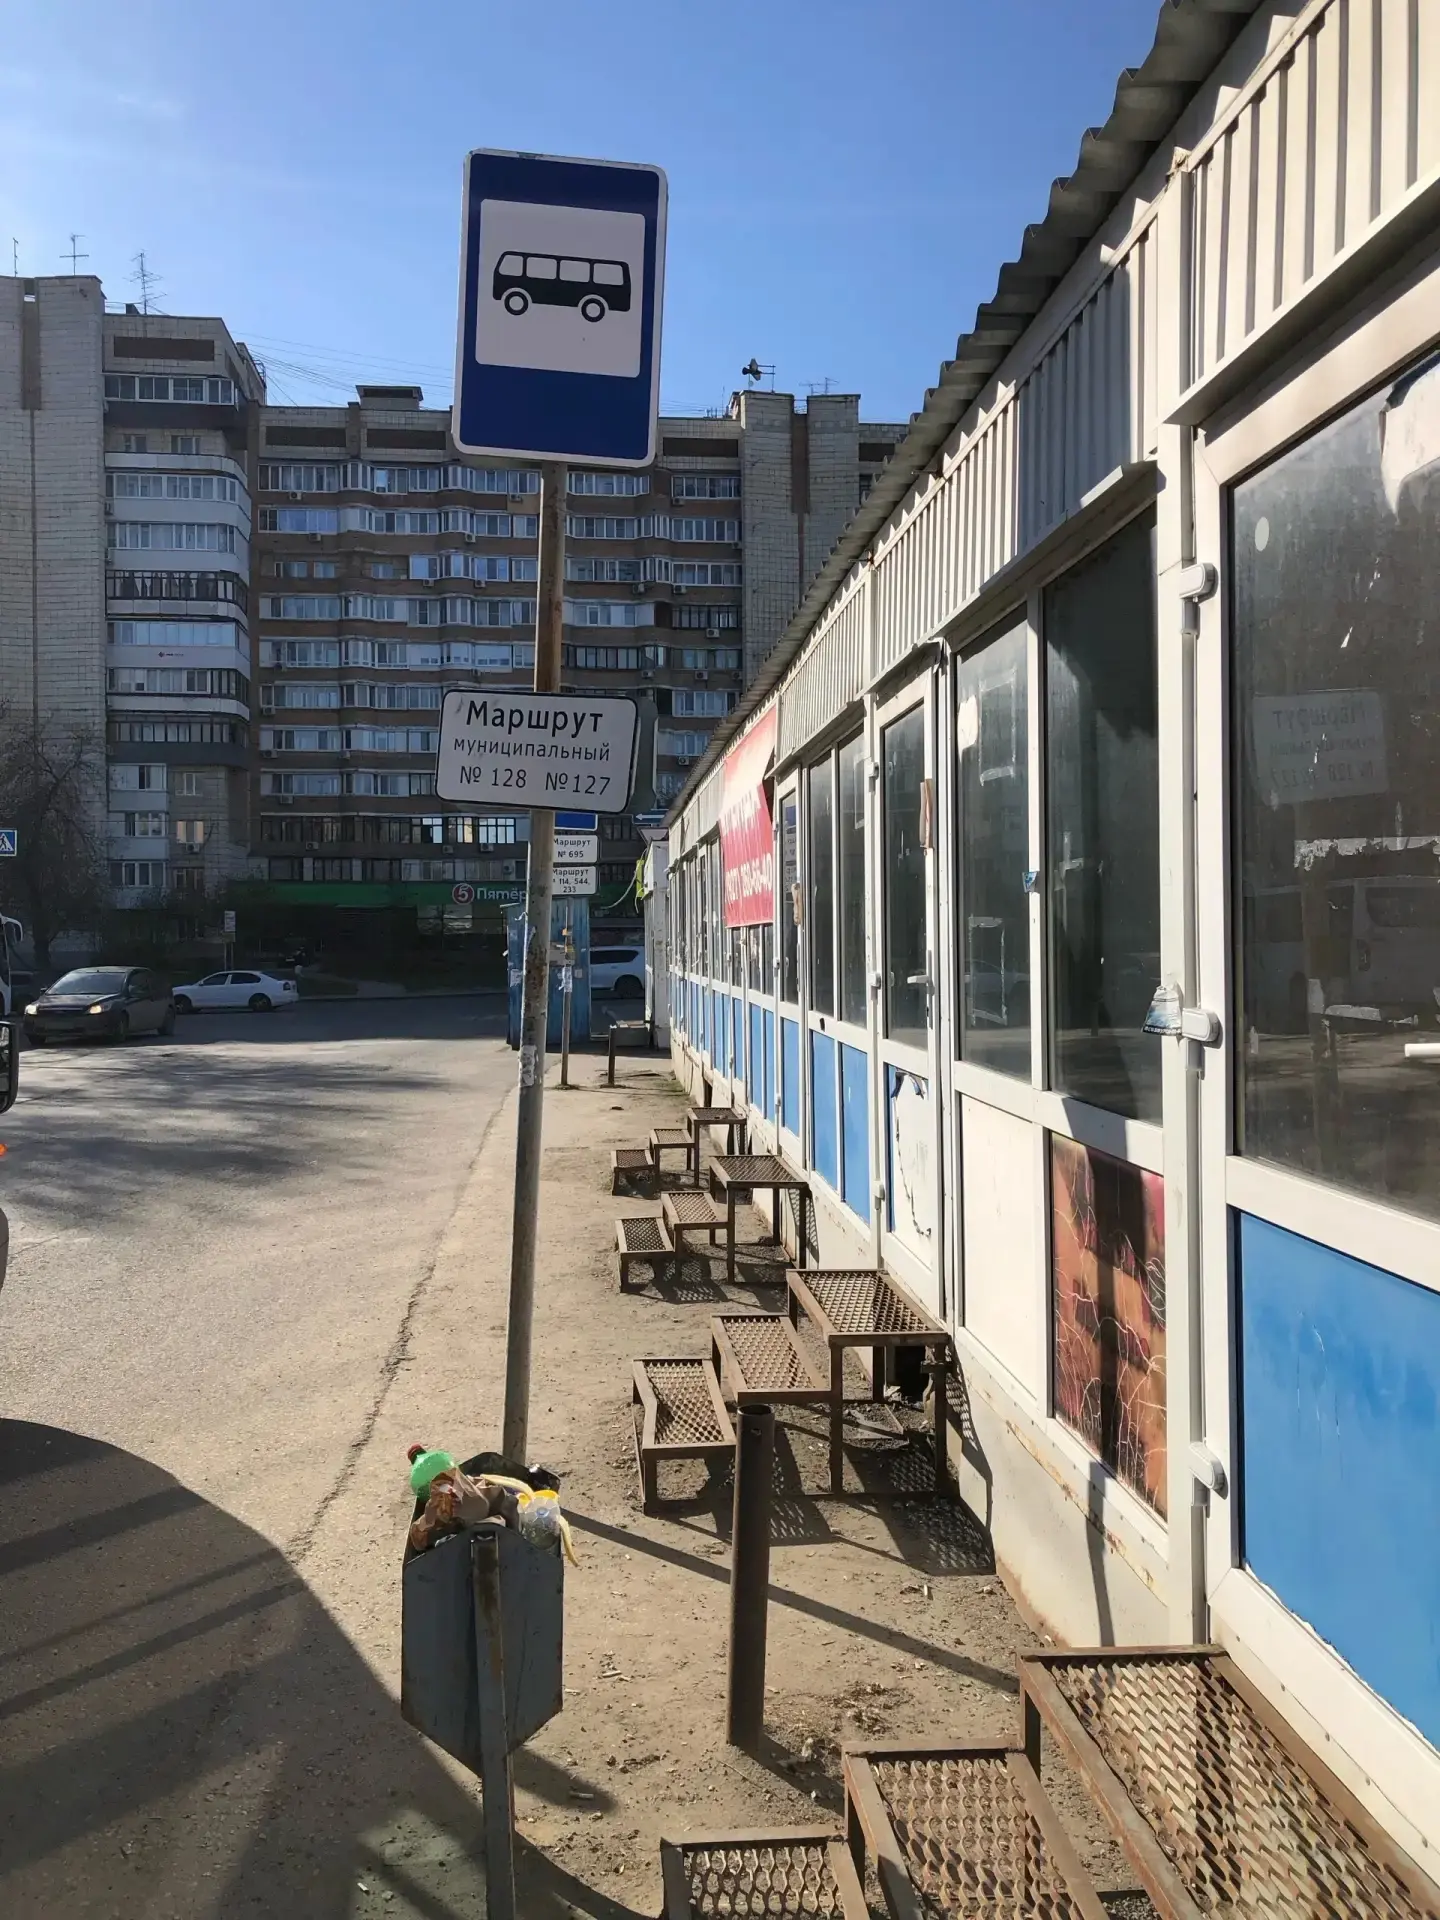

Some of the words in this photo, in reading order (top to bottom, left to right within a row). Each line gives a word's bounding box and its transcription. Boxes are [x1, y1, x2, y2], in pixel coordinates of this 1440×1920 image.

[466, 700, 603, 738] Маршрут
[453, 737, 610, 762] муниципальный
[459, 765, 482, 785] №
[491, 767, 527, 788] 128
[568, 850, 584, 858] 695
[477, 887, 527, 903] Пятёр
